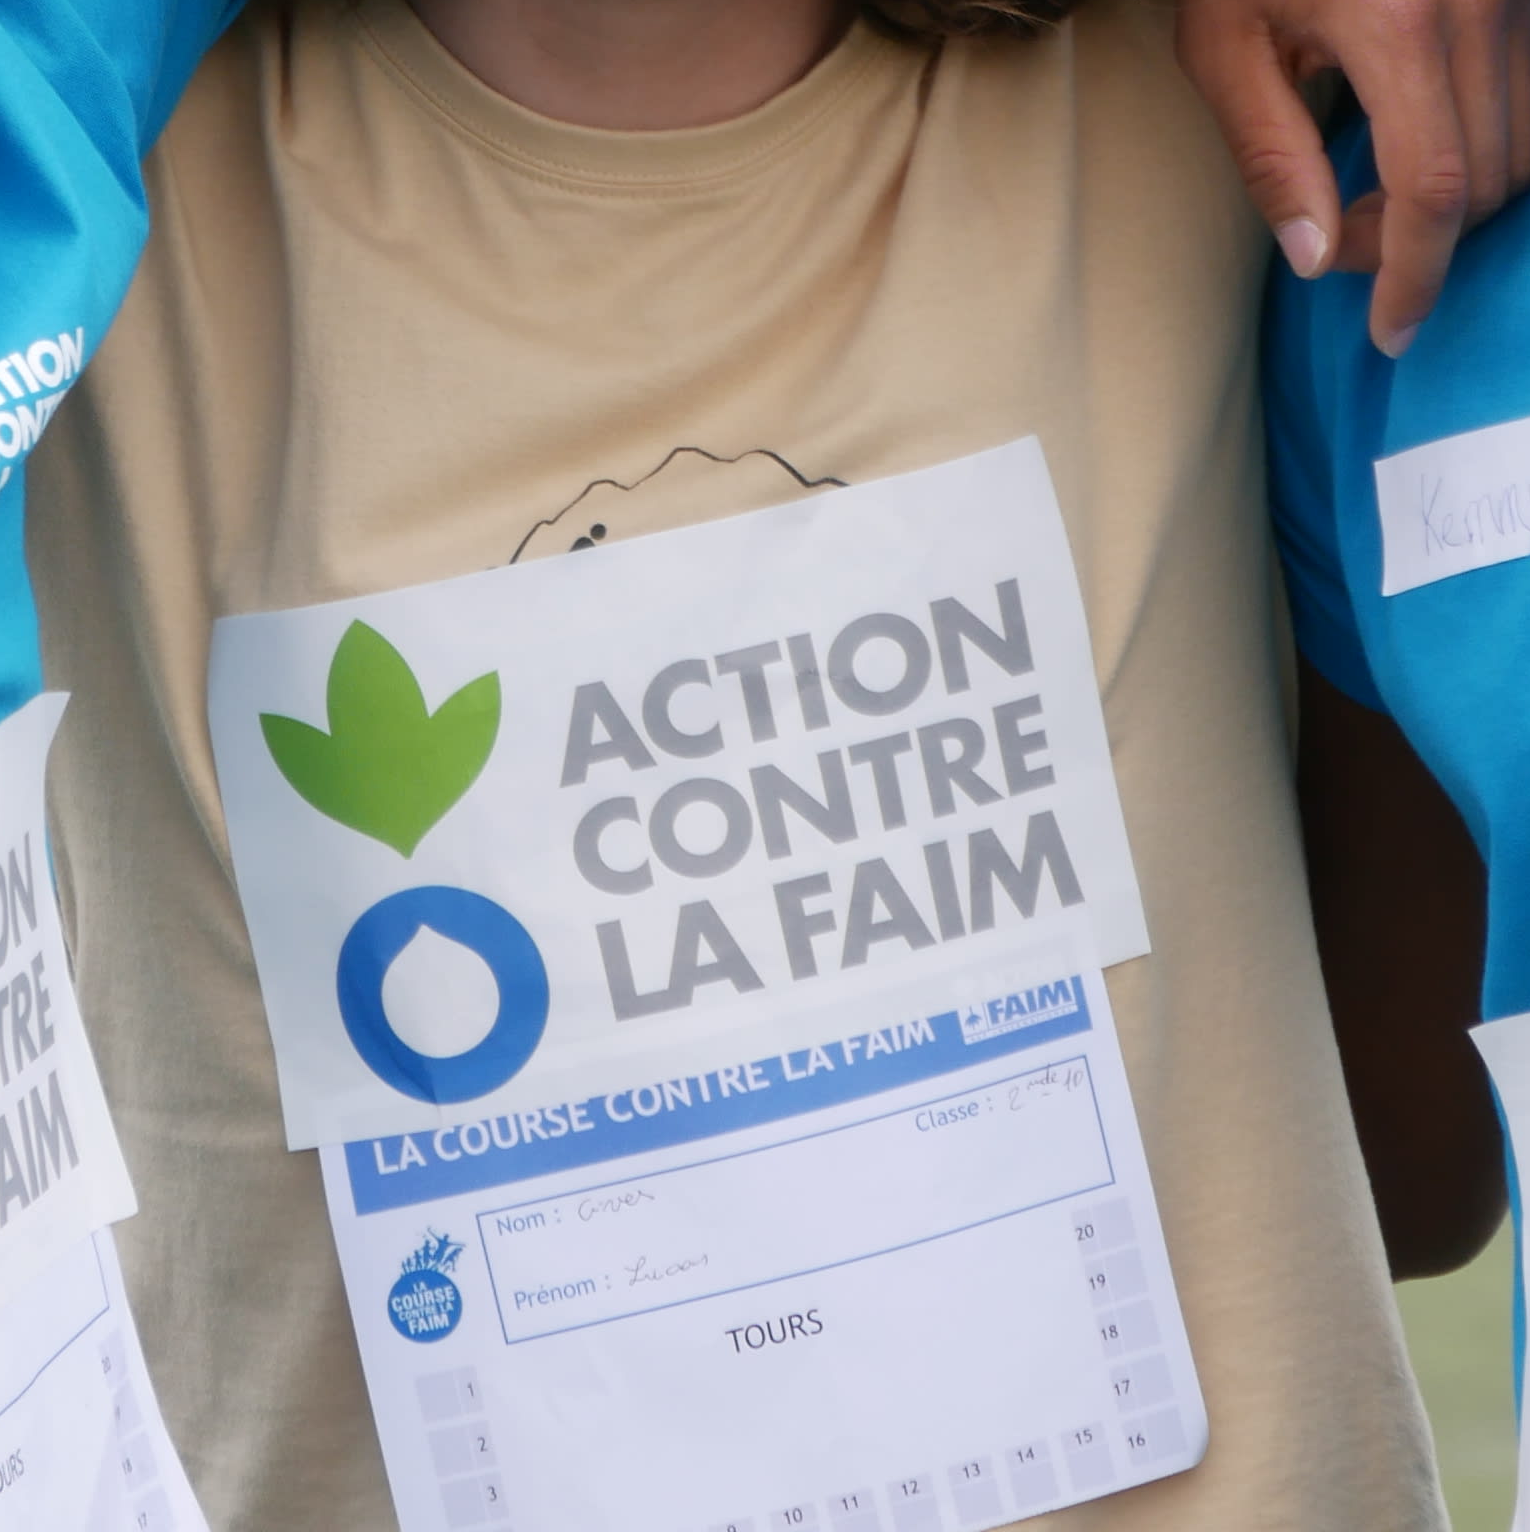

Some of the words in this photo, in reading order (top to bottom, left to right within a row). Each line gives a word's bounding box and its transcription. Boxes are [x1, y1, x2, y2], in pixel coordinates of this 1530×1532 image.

[560, 578, 1035, 788] ACTION
[573, 694, 1056, 896] CONTRE
[596, 899, 765, 1022] LA
[773, 810, 1085, 981] FAIM
[986, 979, 1073, 1025] FAIM
[373, 1137, 426, 1175] LA
[433, 1101, 595, 1161] COURSE
[604, 1062, 771, 1124] CONTRE
[780, 1045, 834, 1081] LA
[843, 1019, 937, 1066] FAIM
[915, 1101, 979, 1132] Classe
[496, 1209, 546, 1236] Nom
[1075, 1224, 1095, 1241] 20
[1089, 1274, 1107, 1290] 19
[391, 1286, 455, 1313] COURSE
[513, 1275, 597, 1311] Prénom
[408, 1313, 450, 1335] FAIM
[725, 1308, 824, 1354] TOURS
[1101, 1325, 1119, 1341] 18
[1114, 1380, 1131, 1397] 17
[477, 1436, 488, 1453] 2
[1075, 1428, 1094, 1446] 15
[1128, 1433, 1146, 1450] 16
[1017, 1447, 1036, 1464] 14
[963, 1462, 981, 1479] 13
[487, 1486, 498, 1502] 3
[901, 1480, 921, 1496] 12
[842, 1495, 860, 1511] 11
[783, 1508, 804, 1525] 10
